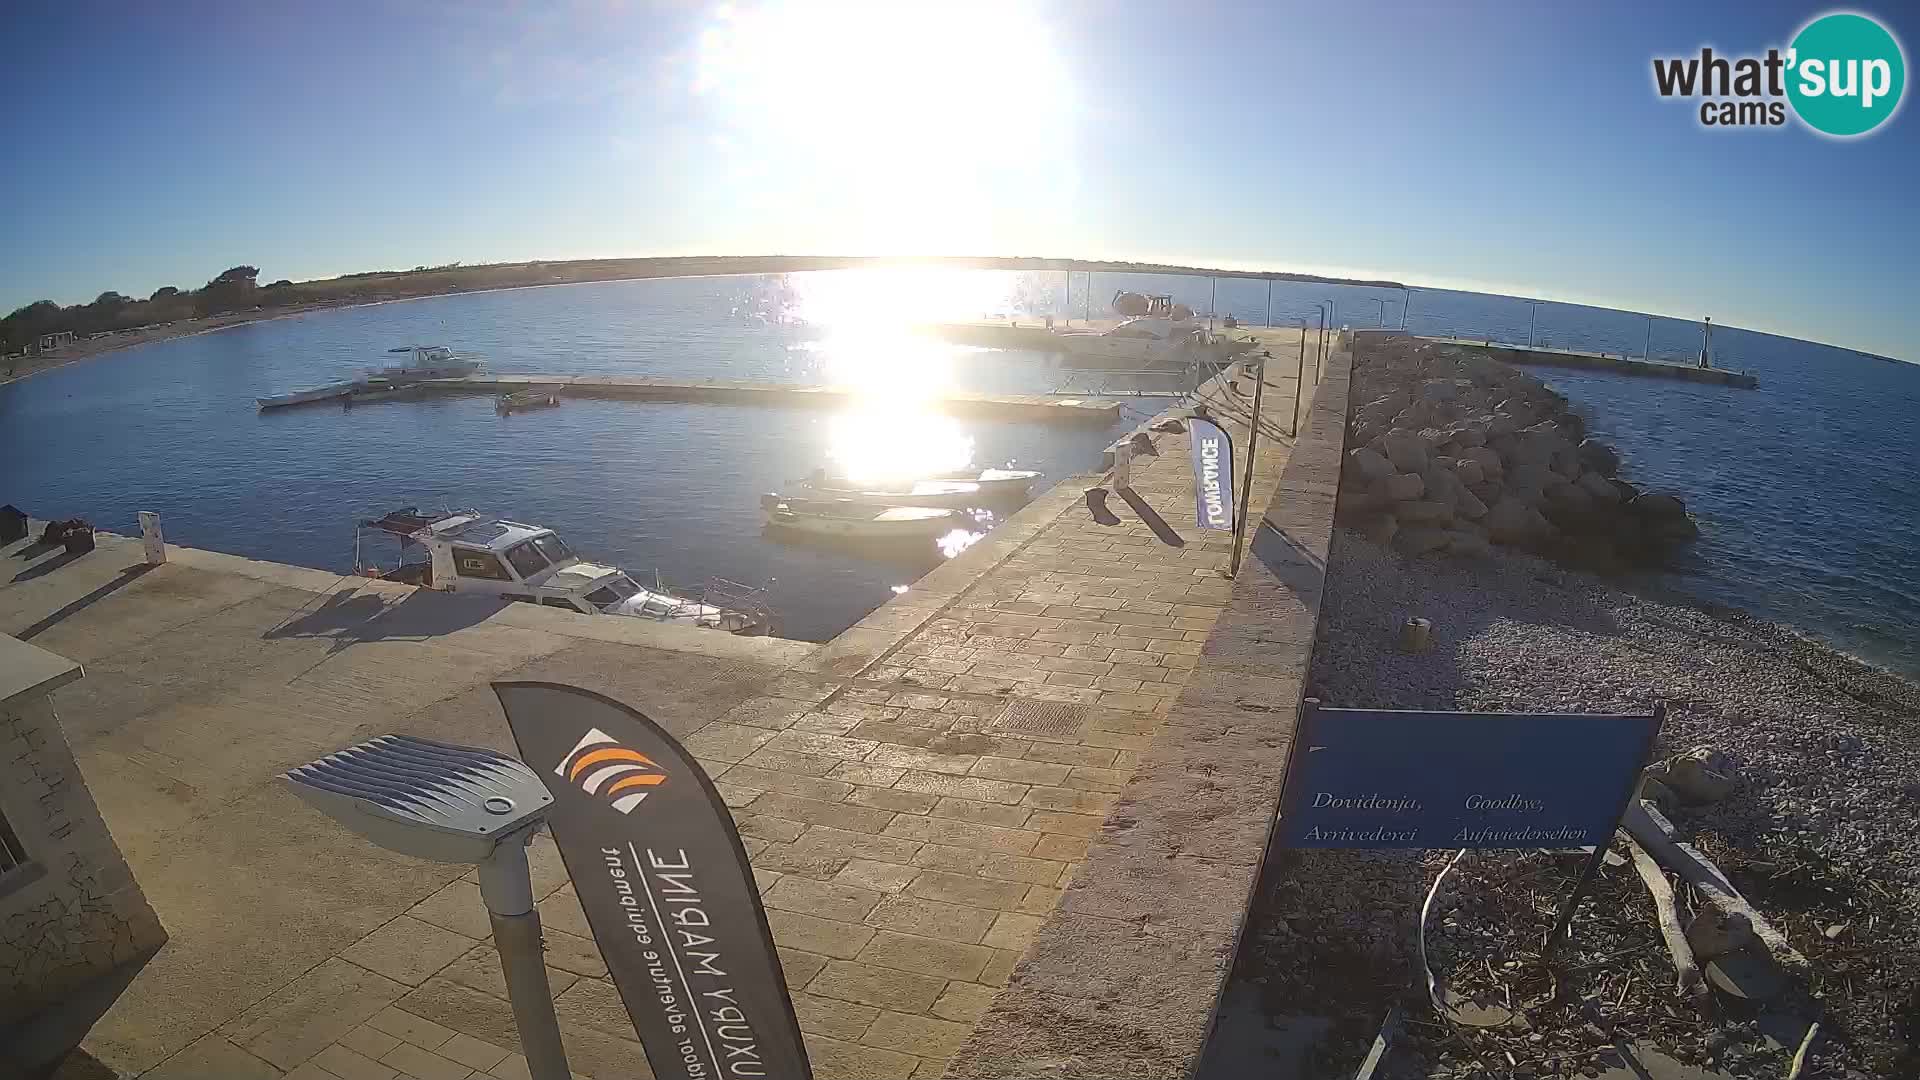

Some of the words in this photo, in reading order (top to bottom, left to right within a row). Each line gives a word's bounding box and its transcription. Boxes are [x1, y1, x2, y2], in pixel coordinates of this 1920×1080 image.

[1311, 792, 1422, 812] Dovidenja,
[1465, 793, 1544, 813] Goodbye,
[1303, 825, 1418, 841] Arrivederci
